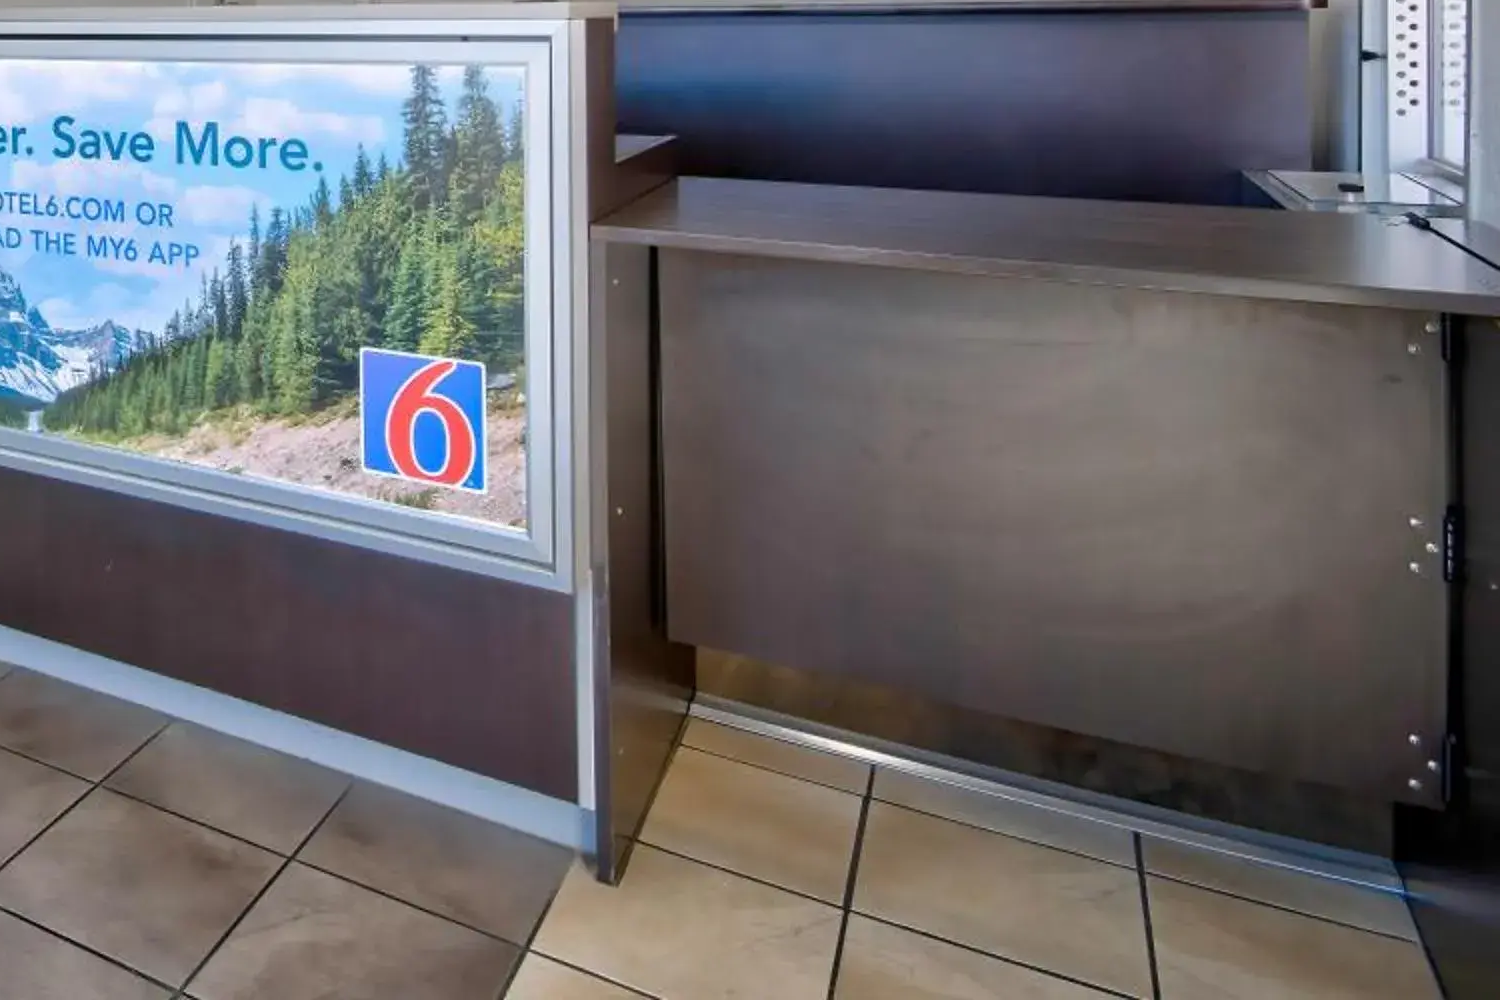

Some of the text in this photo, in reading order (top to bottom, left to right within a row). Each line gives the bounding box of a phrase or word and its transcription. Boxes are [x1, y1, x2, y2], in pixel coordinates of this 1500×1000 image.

[51, 115, 156, 164] Save
[174, 120, 324, 172] More.
[136, 202, 173, 228] OR
[31, 229, 77, 254] THE
[87, 238, 137, 262] MY6
[148, 243, 201, 268] APP
[385, 359, 476, 487] 6
